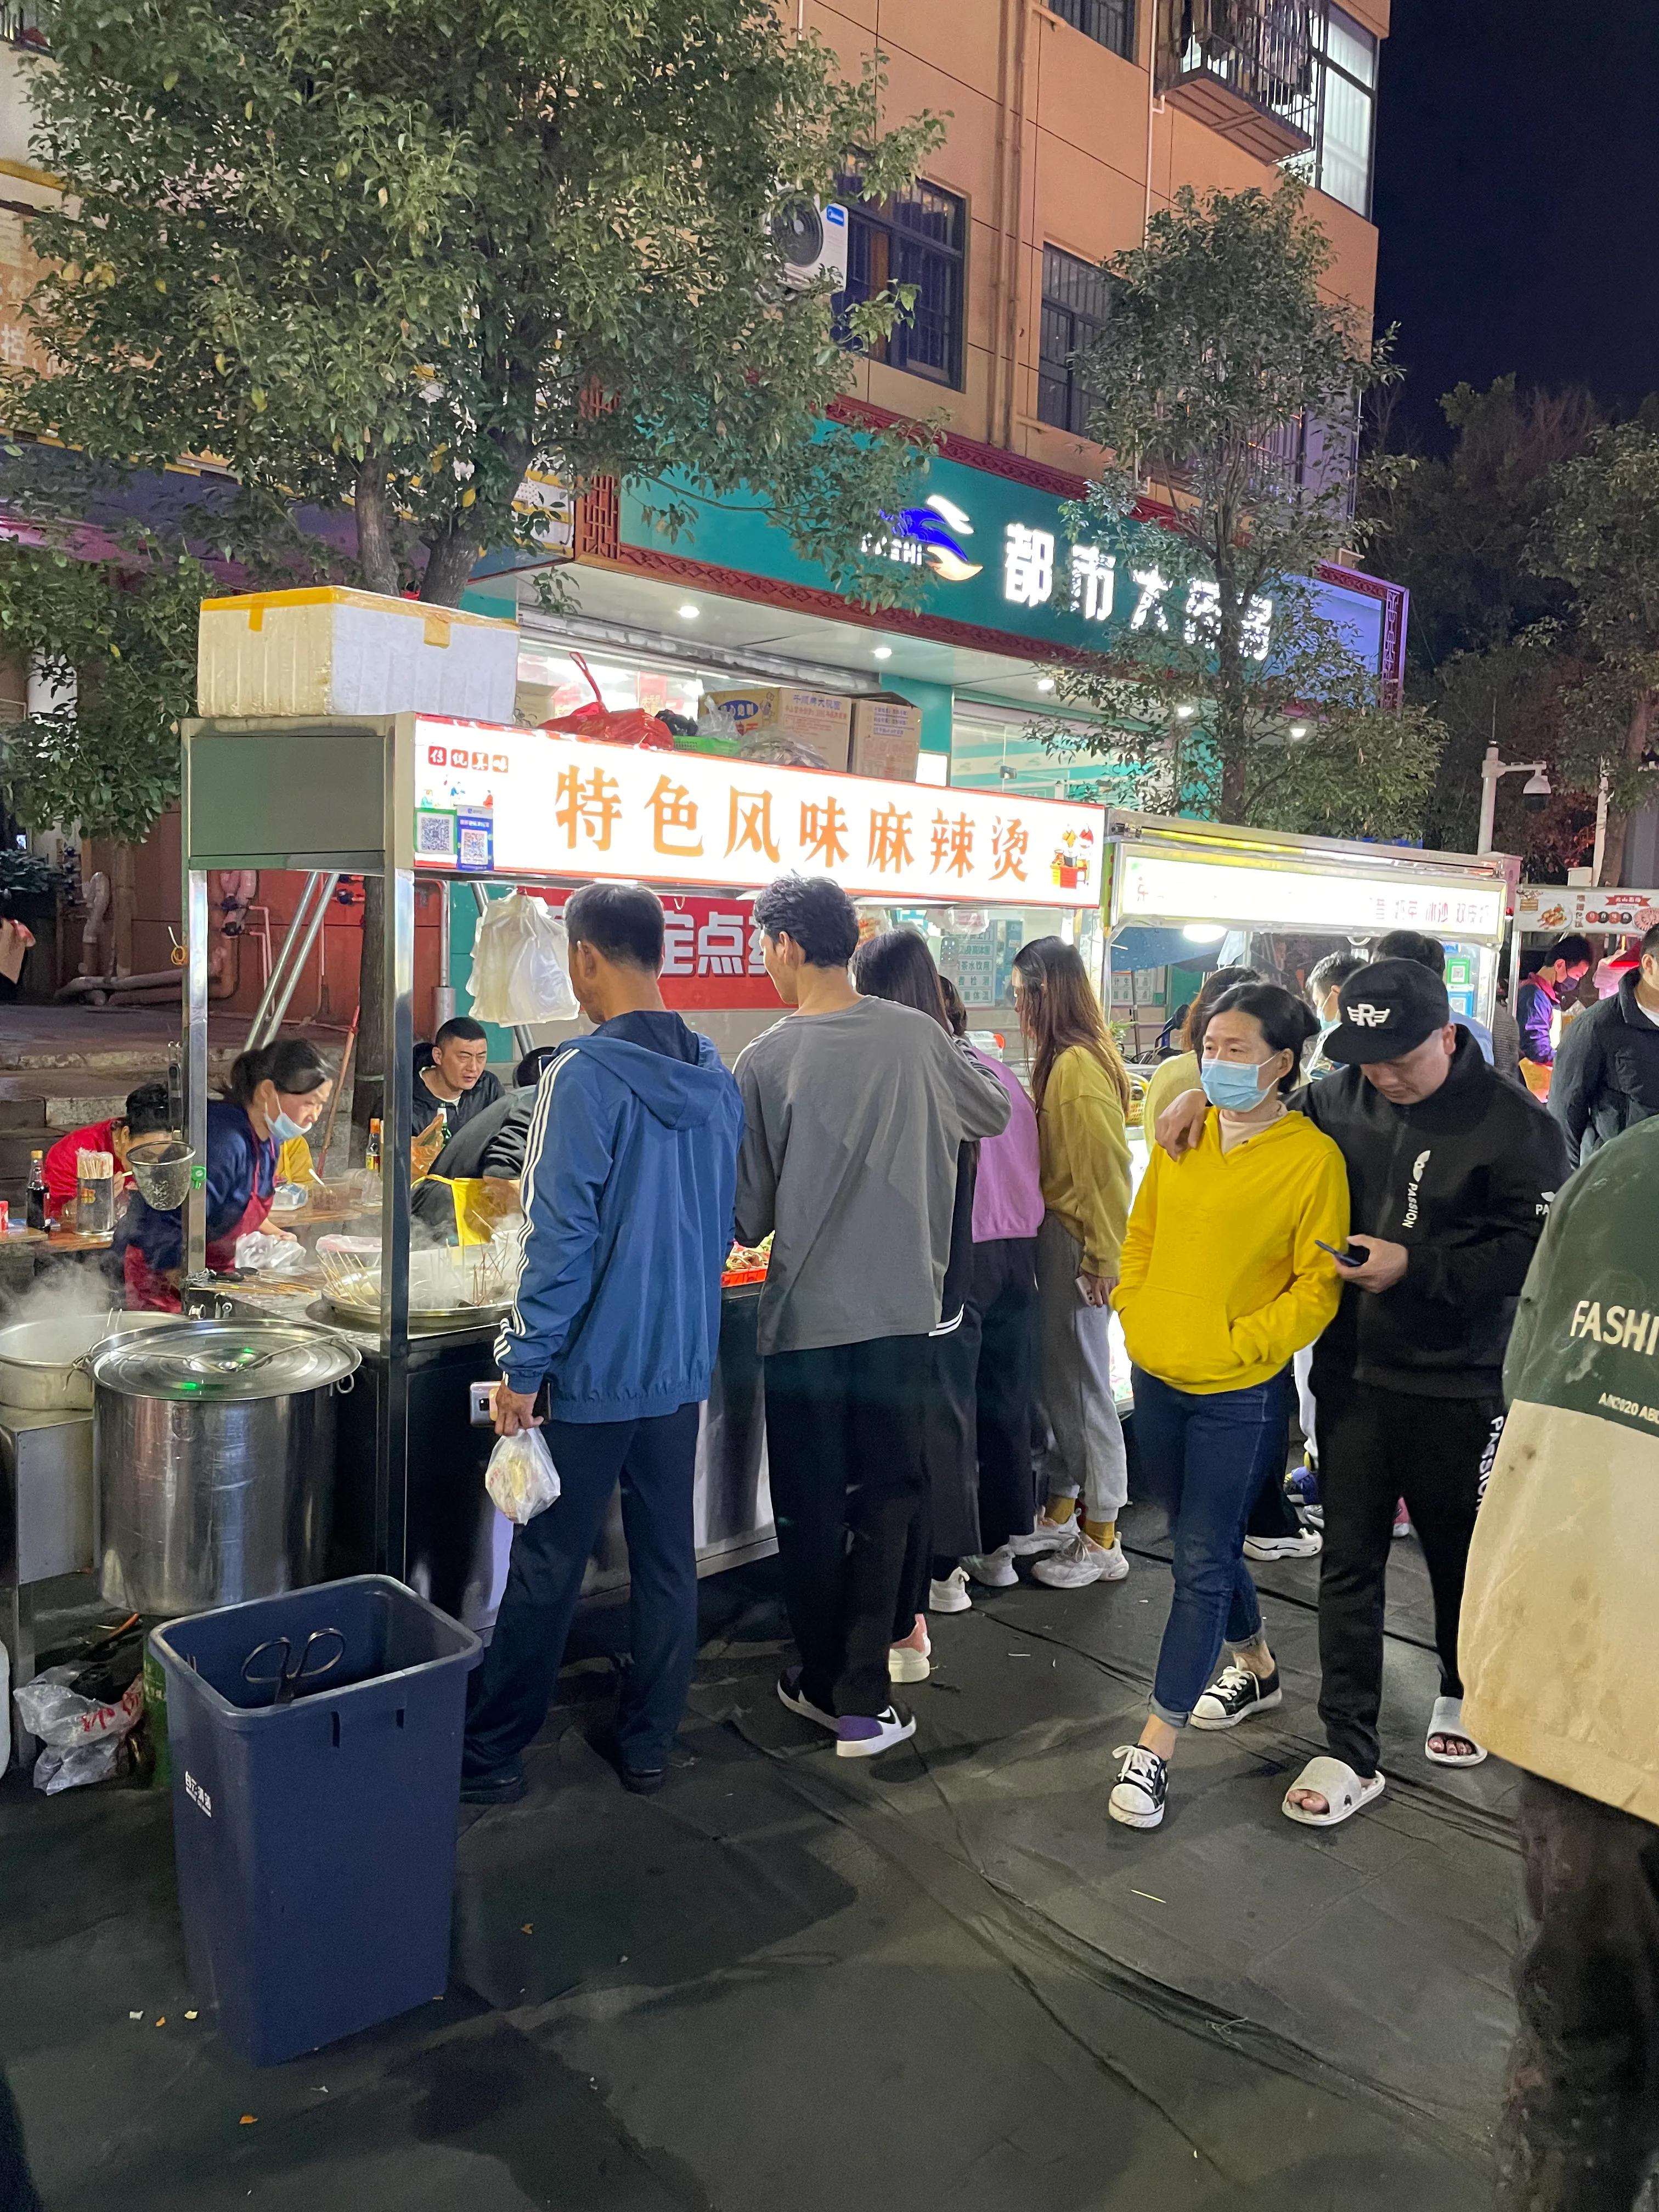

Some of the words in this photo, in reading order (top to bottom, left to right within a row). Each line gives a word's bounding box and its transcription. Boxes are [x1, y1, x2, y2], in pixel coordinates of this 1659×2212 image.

[555, 764, 1029, 883] 特色风味麻辣烫
